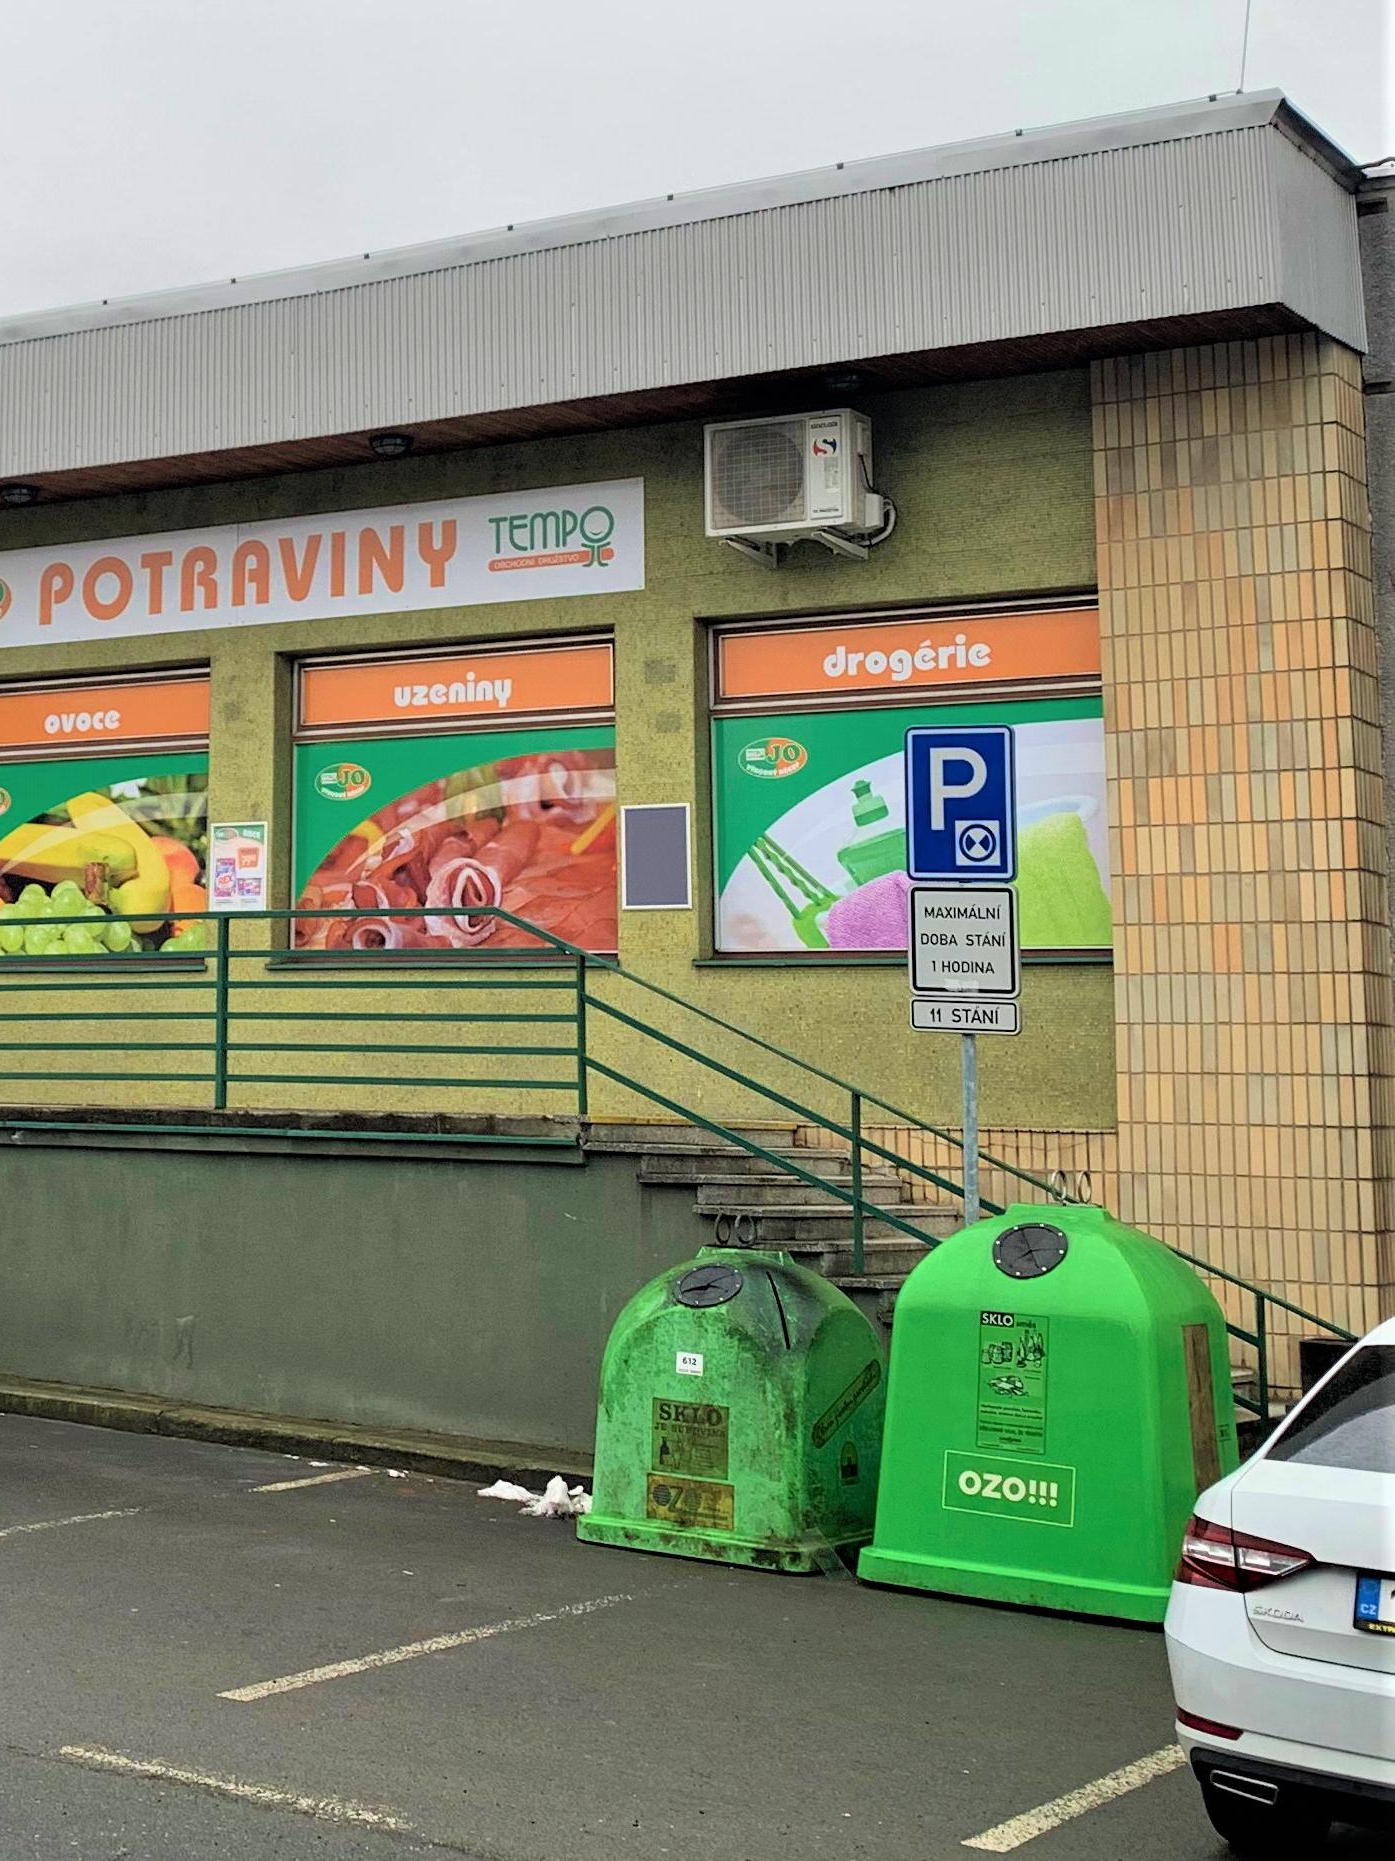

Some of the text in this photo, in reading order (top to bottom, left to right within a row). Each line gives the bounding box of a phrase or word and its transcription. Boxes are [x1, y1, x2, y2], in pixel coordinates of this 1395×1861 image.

[488, 505, 614, 554] TEMPO
[38, 518, 458, 626] POTRAVINY
[823, 633, 992, 682] drogérie
[394, 671, 513, 708] uzeniny
[43, 710, 122, 734] ovoce
[929, 747, 988, 831] P
[924, 904, 1002, 920] MAXIMÁLNÍ
[920, 931, 1006, 947] DOBA STÁNÍ
[932, 960, 995, 974] 1 HODINA
[930, 1006, 1000, 1024] 11 STÁNÍ
[982, 1313, 1013, 1326] SKLO
[682, 1356, 697, 1366] 612
[659, 1403, 723, 1427] SKLO
[958, 1470, 1058, 1507] OZO!!!
[1360, 1603, 1377, 1615] CZ
